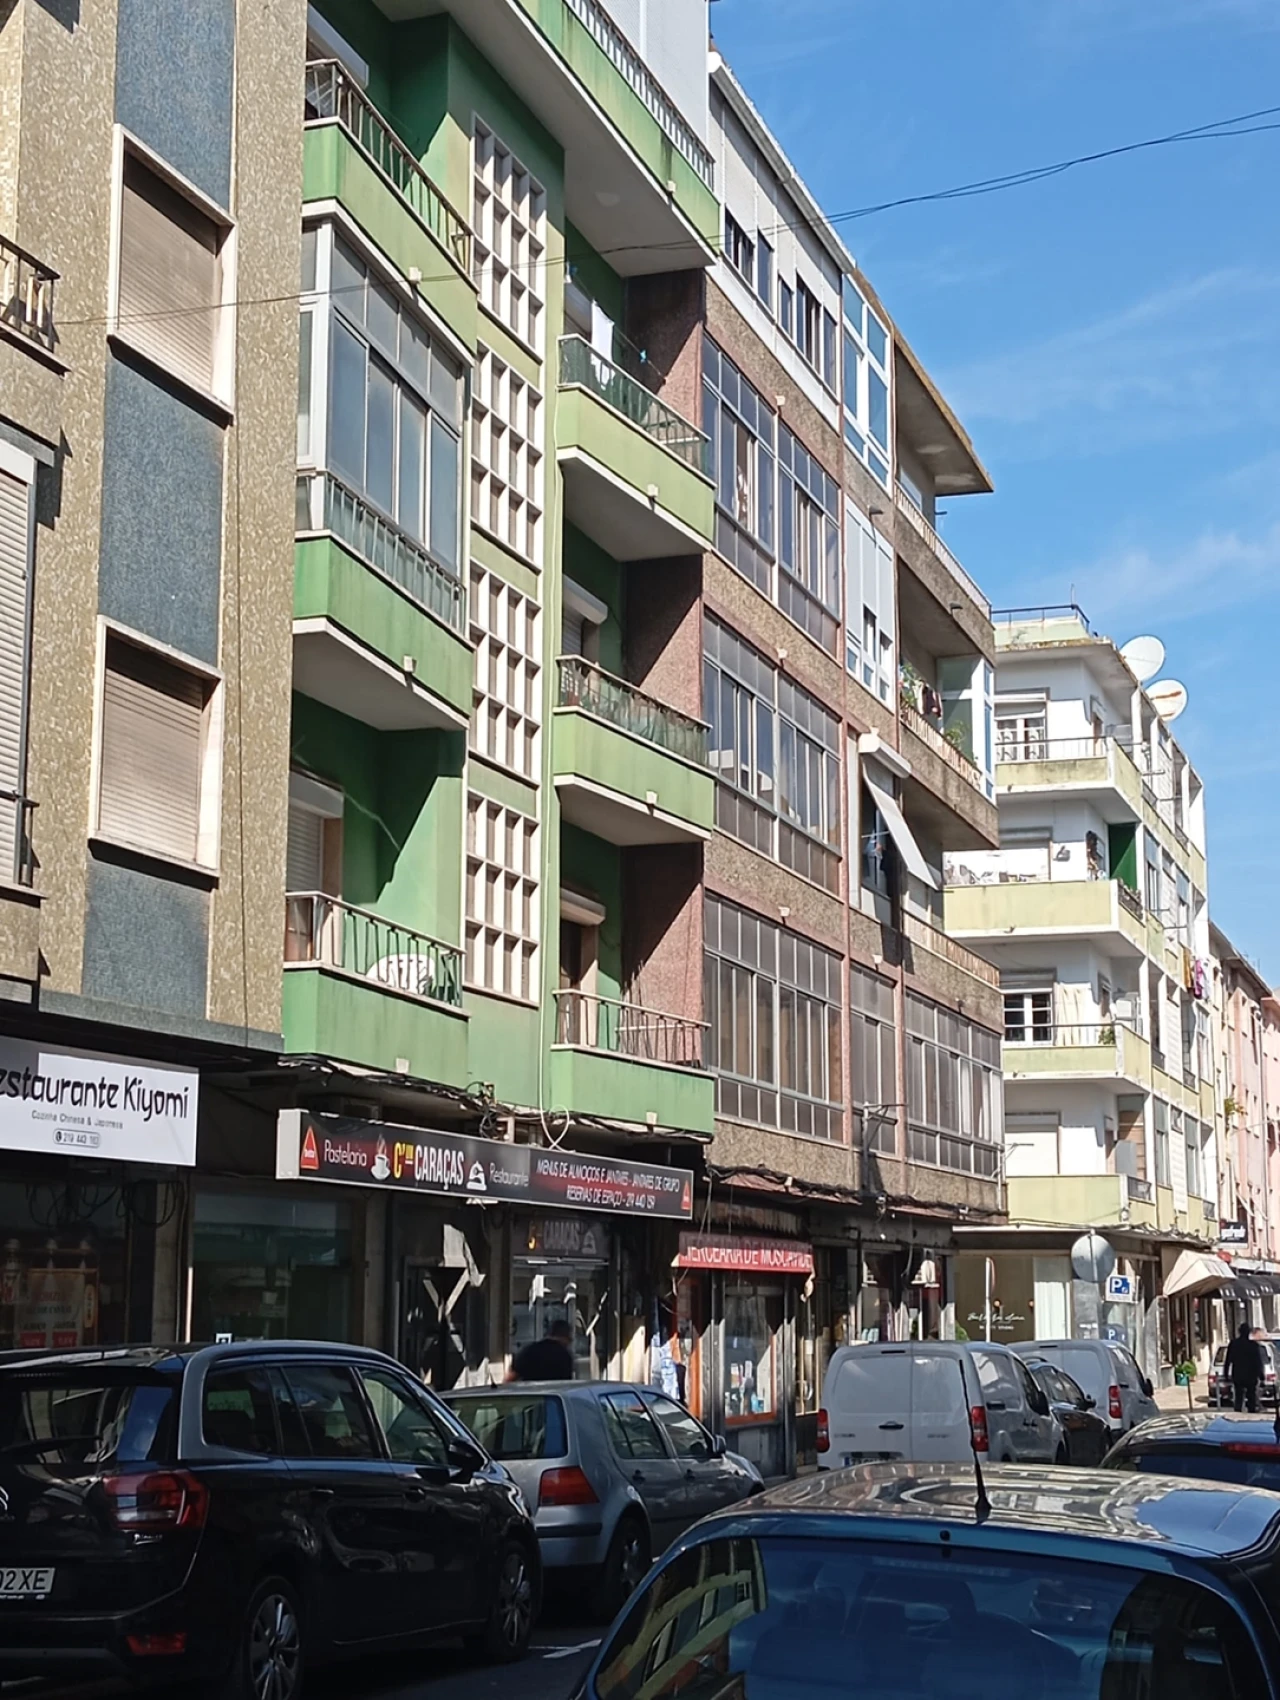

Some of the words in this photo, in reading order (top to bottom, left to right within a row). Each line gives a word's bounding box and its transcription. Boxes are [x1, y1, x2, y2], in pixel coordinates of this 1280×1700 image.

[123, 1076, 189, 1122] Kiyomi
[59, 1113, 85, 1125] Chinesa
[324, 1139, 367, 1167] Pastelaria
[414, 1145, 464, 1190] CARAÇAS
[490, 1162, 529, 1187] Restaurante
[559, 1163, 568, 1178] DE
[744, 1240, 759, 1265] DE
[1111, 1278, 1123, 1292] P
